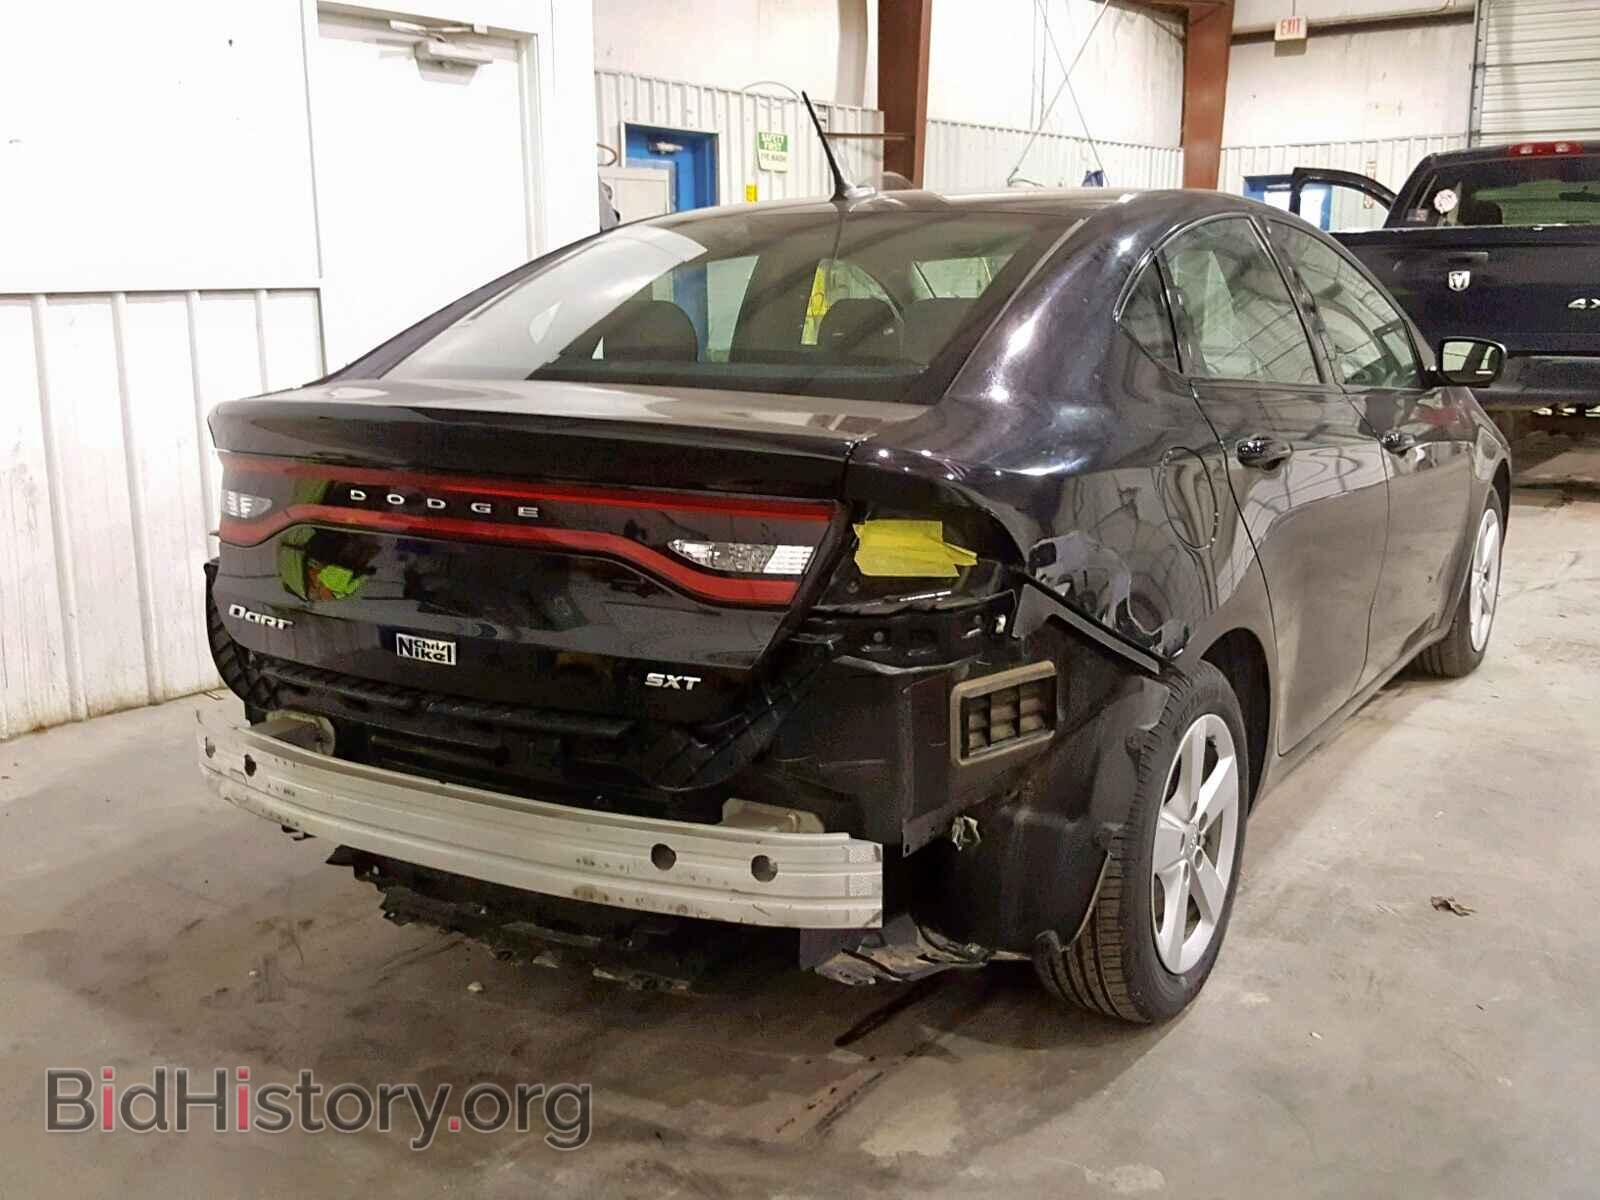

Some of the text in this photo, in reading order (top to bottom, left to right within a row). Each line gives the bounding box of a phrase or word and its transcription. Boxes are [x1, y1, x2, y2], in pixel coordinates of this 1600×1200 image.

[1279, 18, 1301, 35] EXIT
[350, 489, 539, 518] DODGE
[414, 639, 447, 651] Chris
[644, 672, 702, 691] SXT
